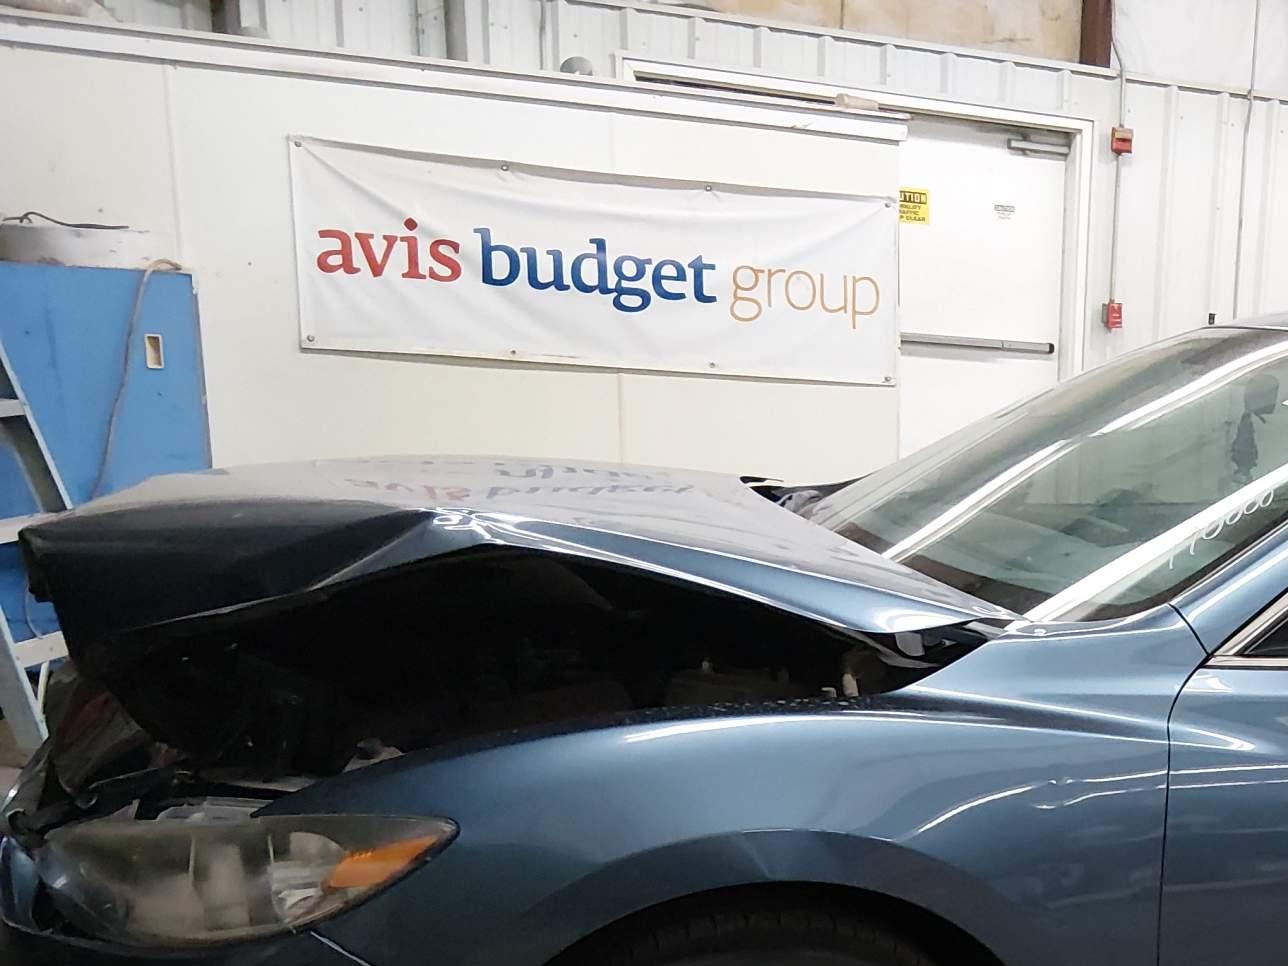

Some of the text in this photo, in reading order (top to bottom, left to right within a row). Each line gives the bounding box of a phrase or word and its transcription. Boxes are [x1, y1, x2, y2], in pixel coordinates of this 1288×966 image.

[316, 217, 880, 329] avis budget group
